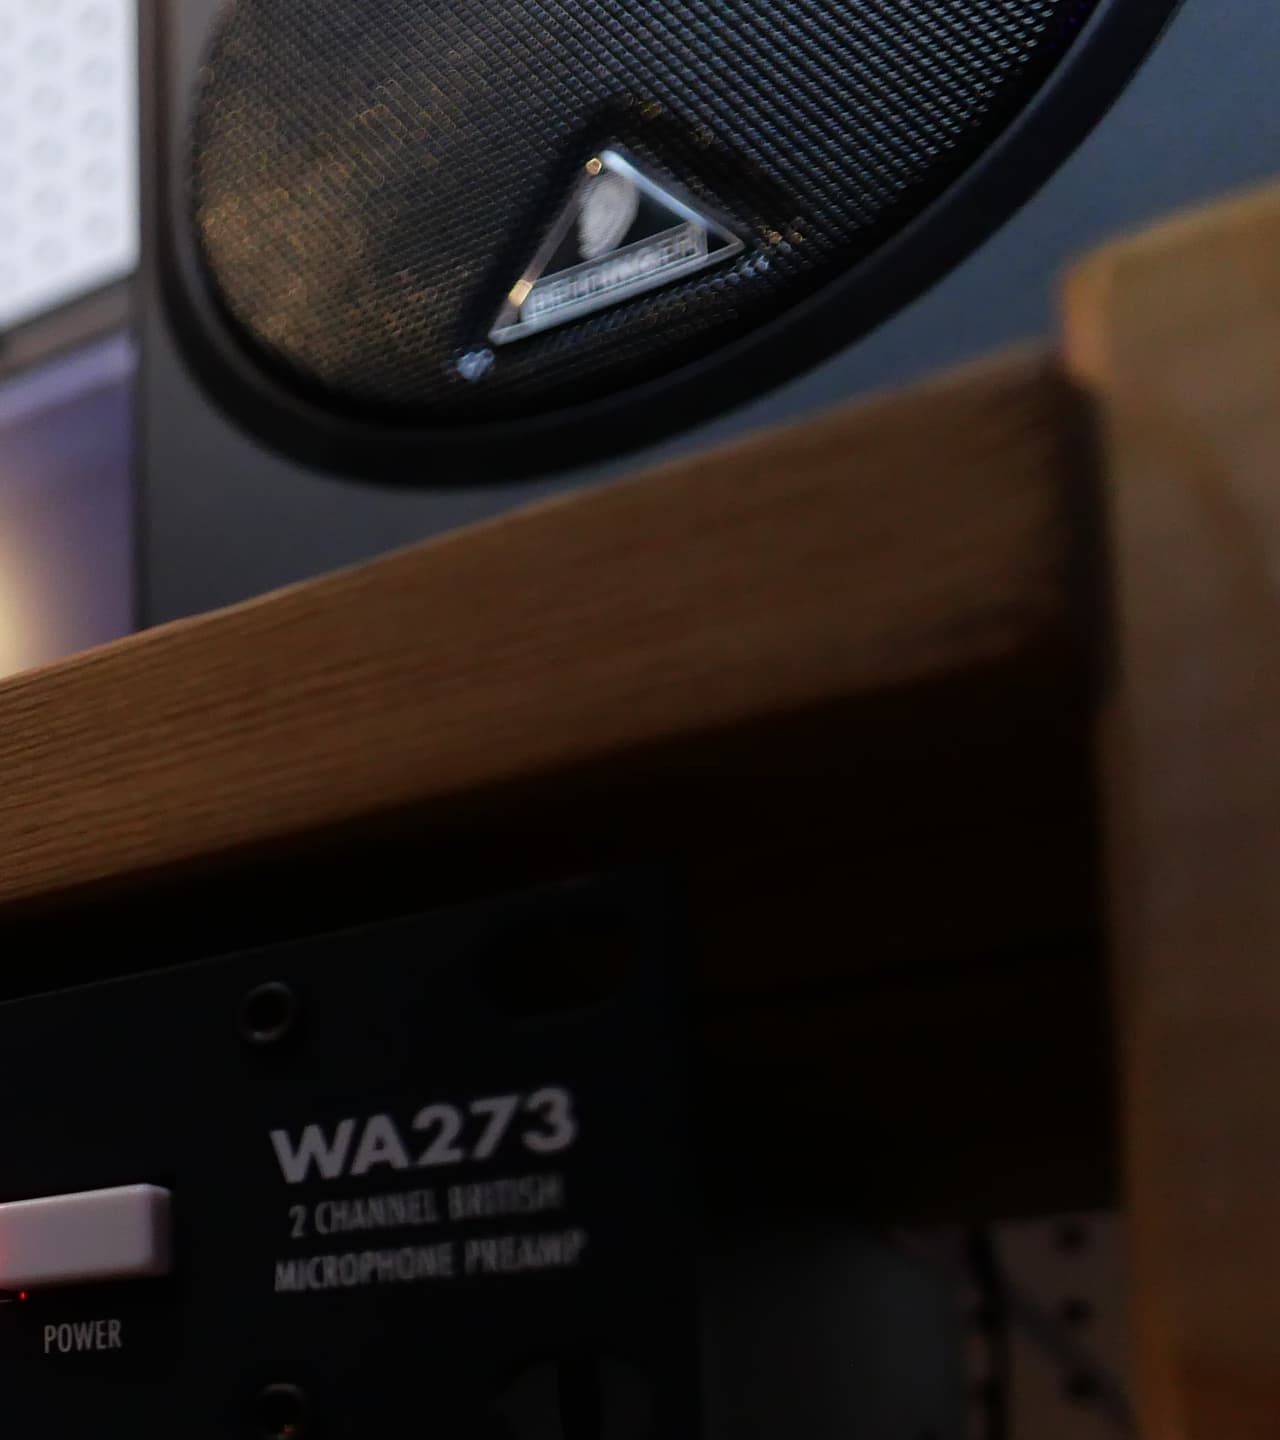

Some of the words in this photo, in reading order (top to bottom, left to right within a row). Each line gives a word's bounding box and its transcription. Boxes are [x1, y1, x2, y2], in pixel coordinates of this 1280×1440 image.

[269, 1084, 579, 1184] WA273
[288, 1204, 308, 1240] 2
[314, 1187, 439, 1236] CHANNEL
[447, 1171, 567, 1223] BRITISH
[274, 1242, 456, 1293] MICROPHONE
[464, 1227, 589, 1276] PREAMP
[44, 1320, 123, 1355] POWER
